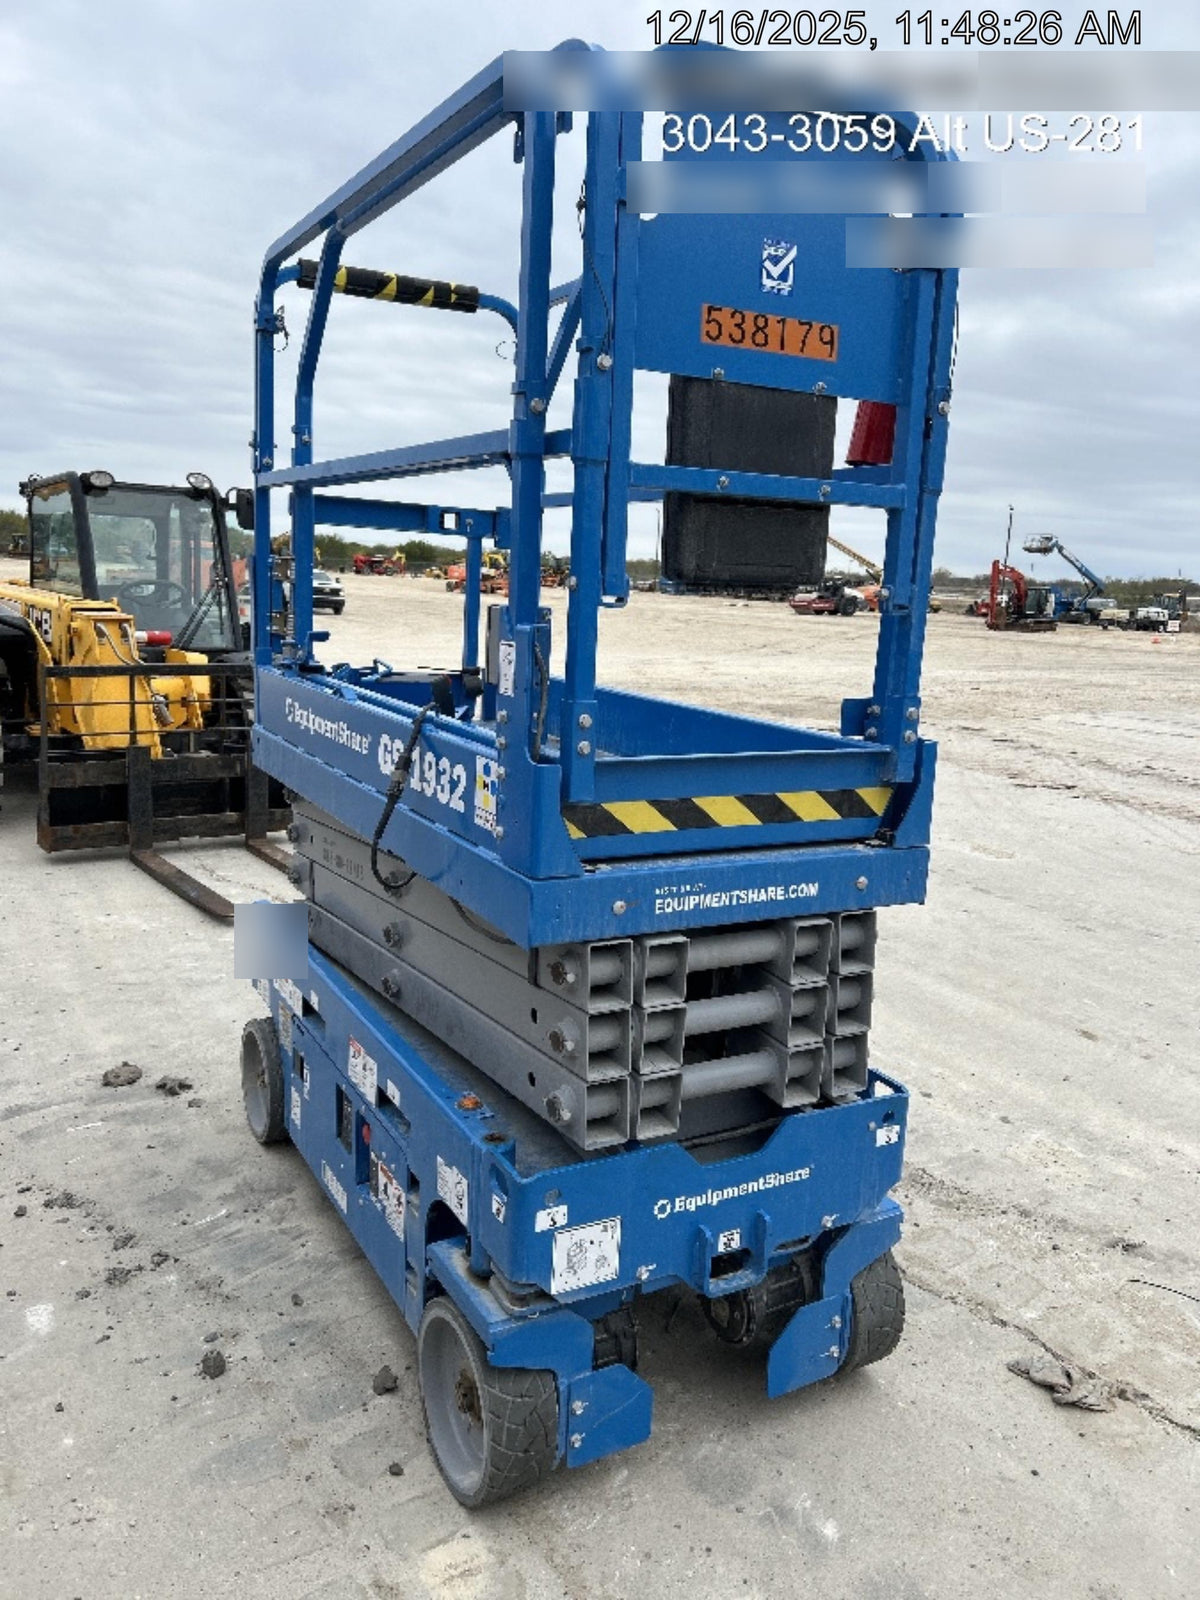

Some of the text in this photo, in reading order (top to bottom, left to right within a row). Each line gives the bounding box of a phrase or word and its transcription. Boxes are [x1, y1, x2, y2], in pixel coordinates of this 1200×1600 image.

[705, 304, 836, 358] 538179
[655, 882, 820, 914] EQUIPMENTSHARE.COM
[673, 1165, 811, 1214] EquipmentShare
